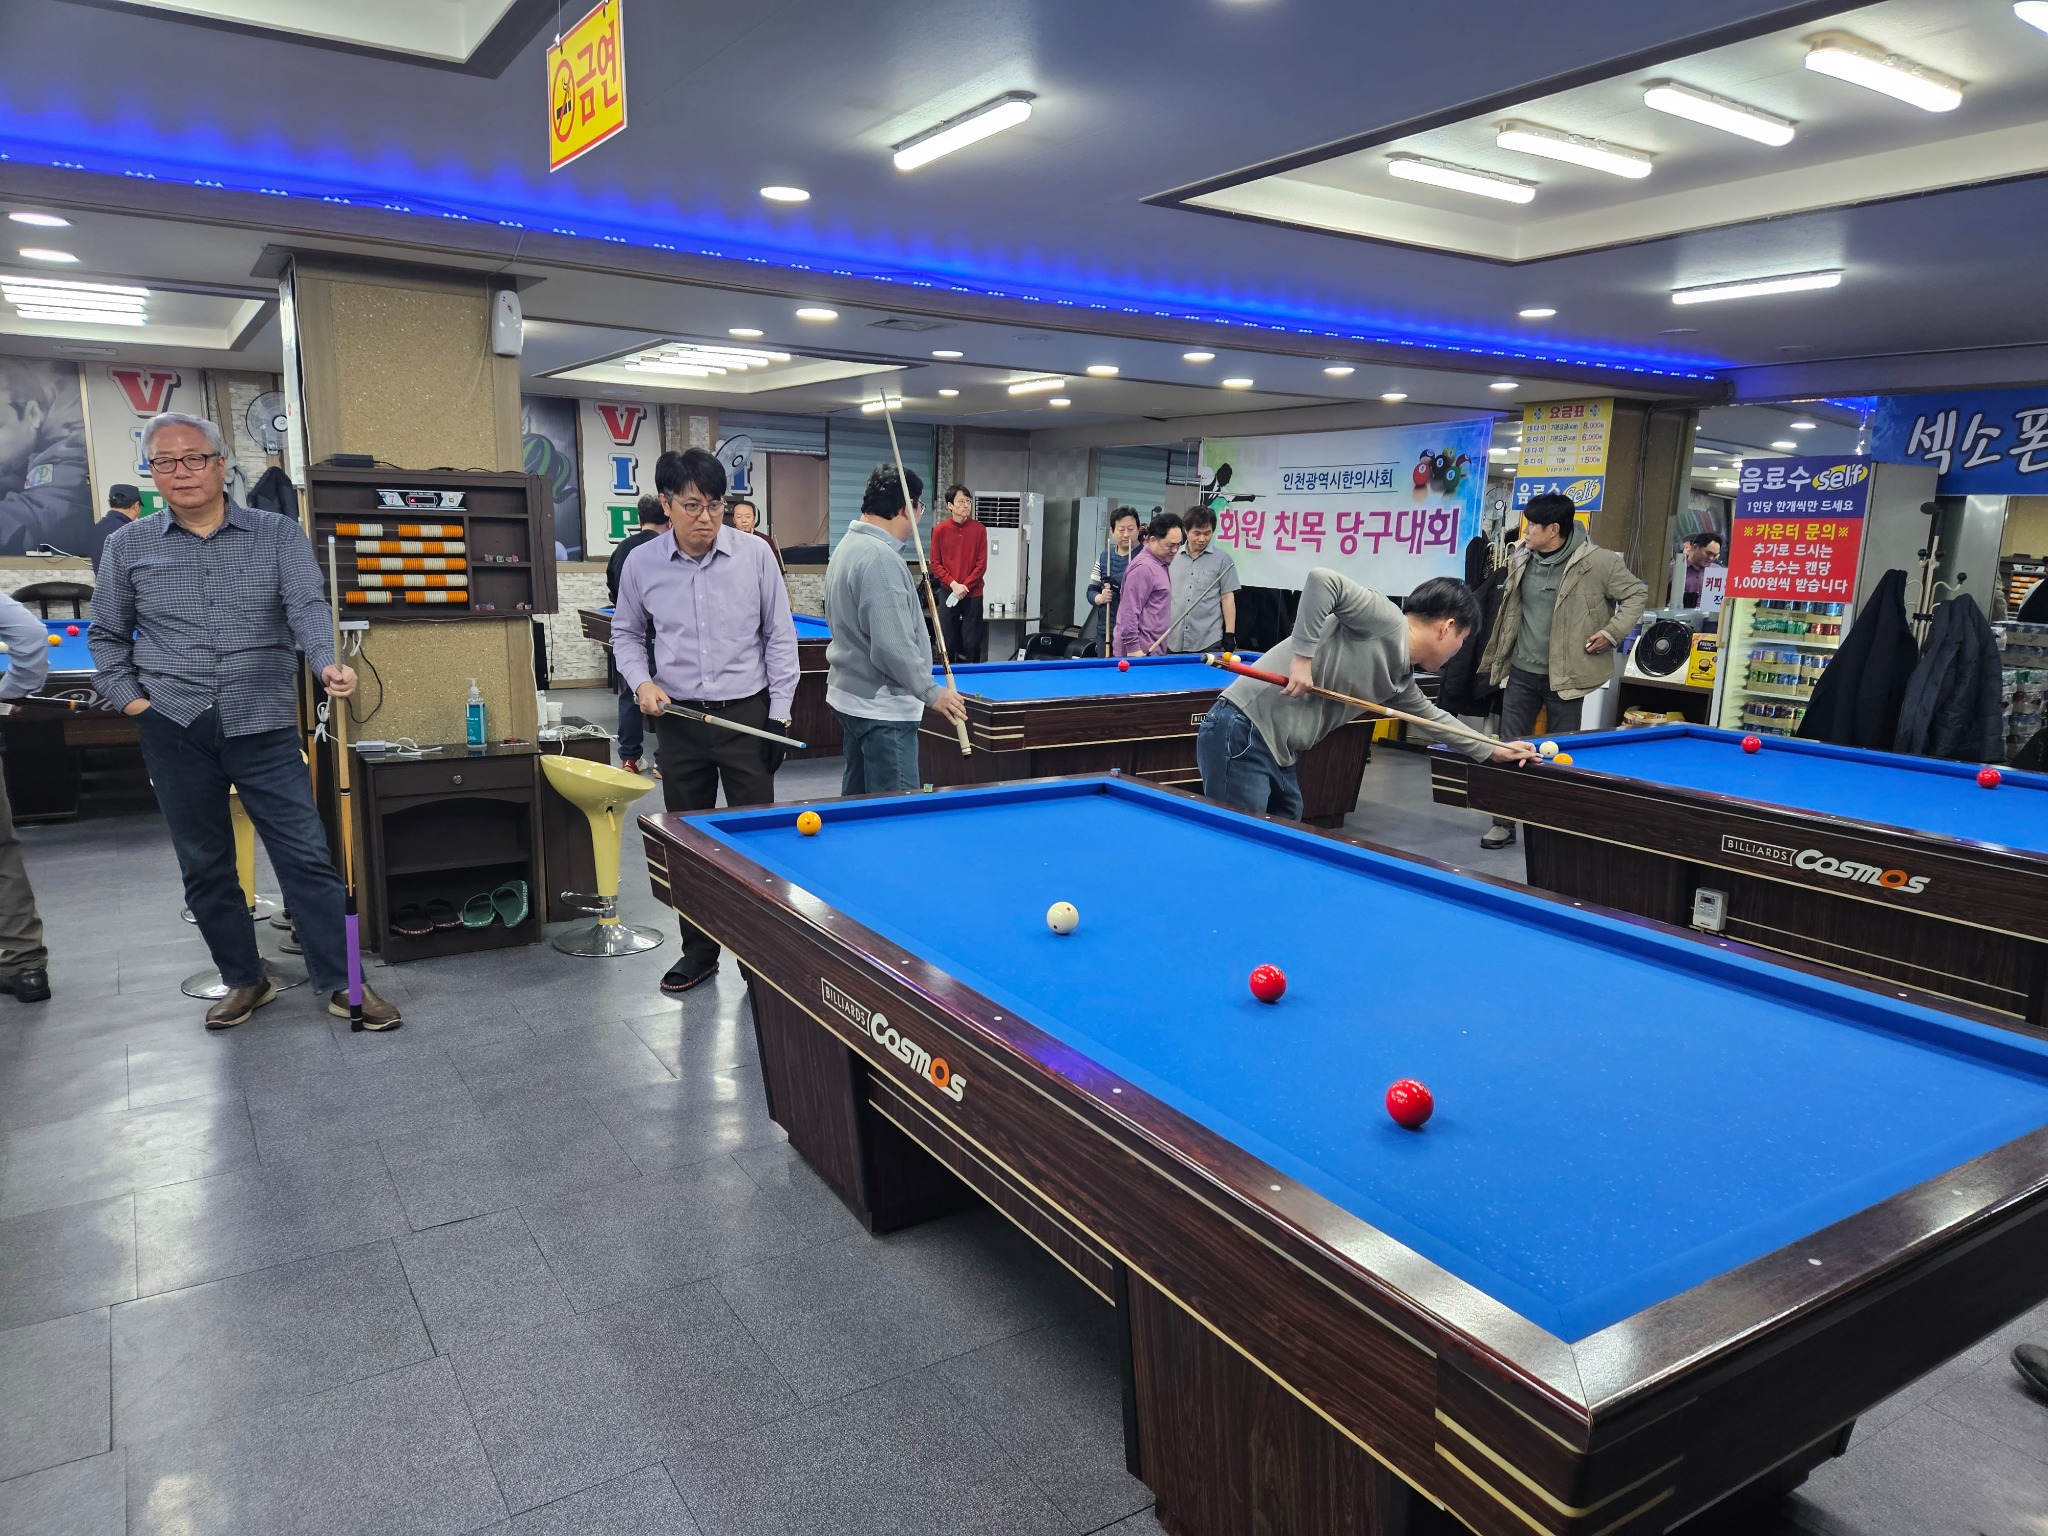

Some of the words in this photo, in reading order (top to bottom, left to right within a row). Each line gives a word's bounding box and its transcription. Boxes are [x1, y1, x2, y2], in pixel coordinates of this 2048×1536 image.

[576, 19, 618, 126] 금연
[1549, 405, 1585, 419] 요금표
[1283, 468, 1394, 490] 인천광역시한의사회
[1740, 465, 1812, 493] 음료수
[1747, 500, 1773, 513] 1인당
[1776, 500, 1818, 513] 한개씩만
[1821, 500, 1854, 512] 드세요
[1217, 508, 1266, 550] 회원
[1274, 510, 1327, 553] 친목
[1335, 507, 1460, 555] 당구대회
[1752, 544, 1790, 558] 추가로
[1794, 544, 1833, 559] 드시는
[1751, 560, 1800, 575] 음료수는
[1805, 561, 1831, 576] 캔당
[1705, 577, 1722, 592] 커피
[1733, 576, 1790, 591] 1,000원씩
[1795, 578, 1848, 594] 받습니다
[1728, 839, 1788, 861] BILLIARDS
[825, 986, 866, 1026] BILLIARDS
